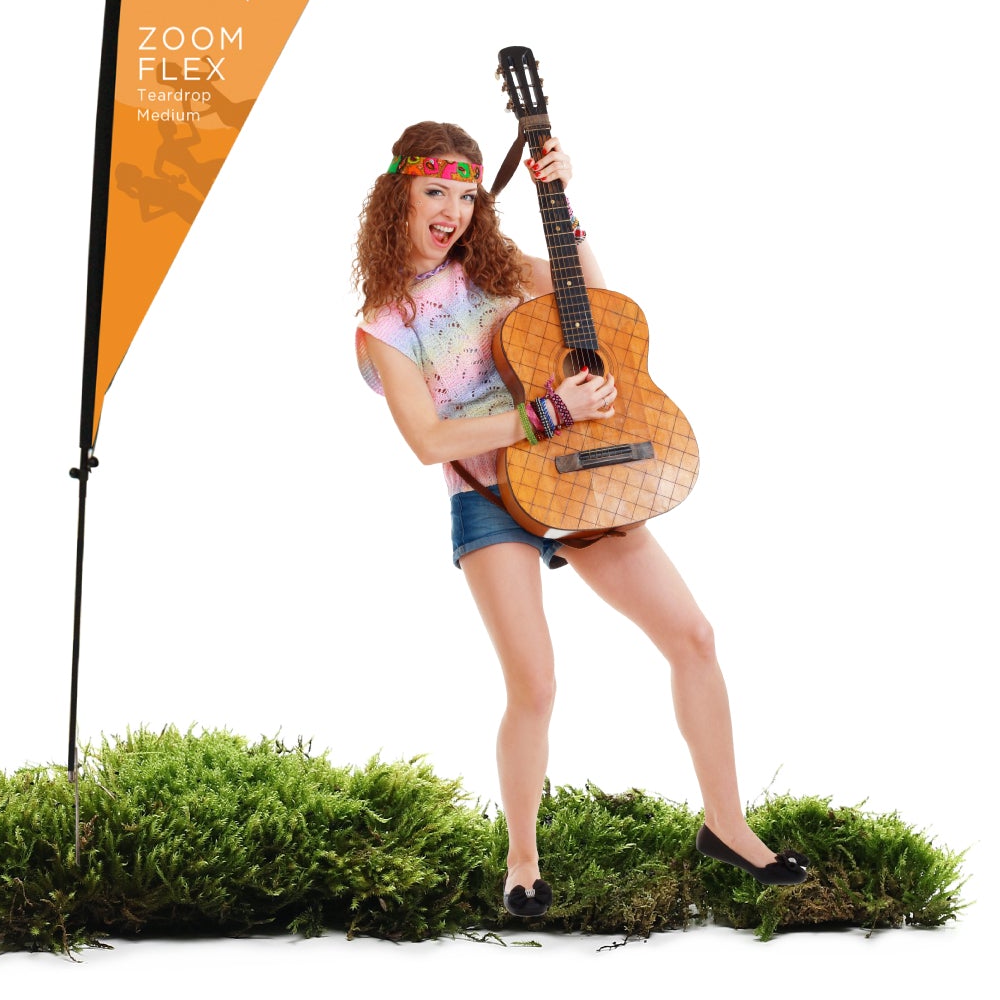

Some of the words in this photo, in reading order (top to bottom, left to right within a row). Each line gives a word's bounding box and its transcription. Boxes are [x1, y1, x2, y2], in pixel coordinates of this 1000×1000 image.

[138, 26, 243, 51] ZOOM
[138, 57, 226, 81] FLEX
[137, 88, 212, 104] Teardrop
[137, 109, 201, 122] Medium
